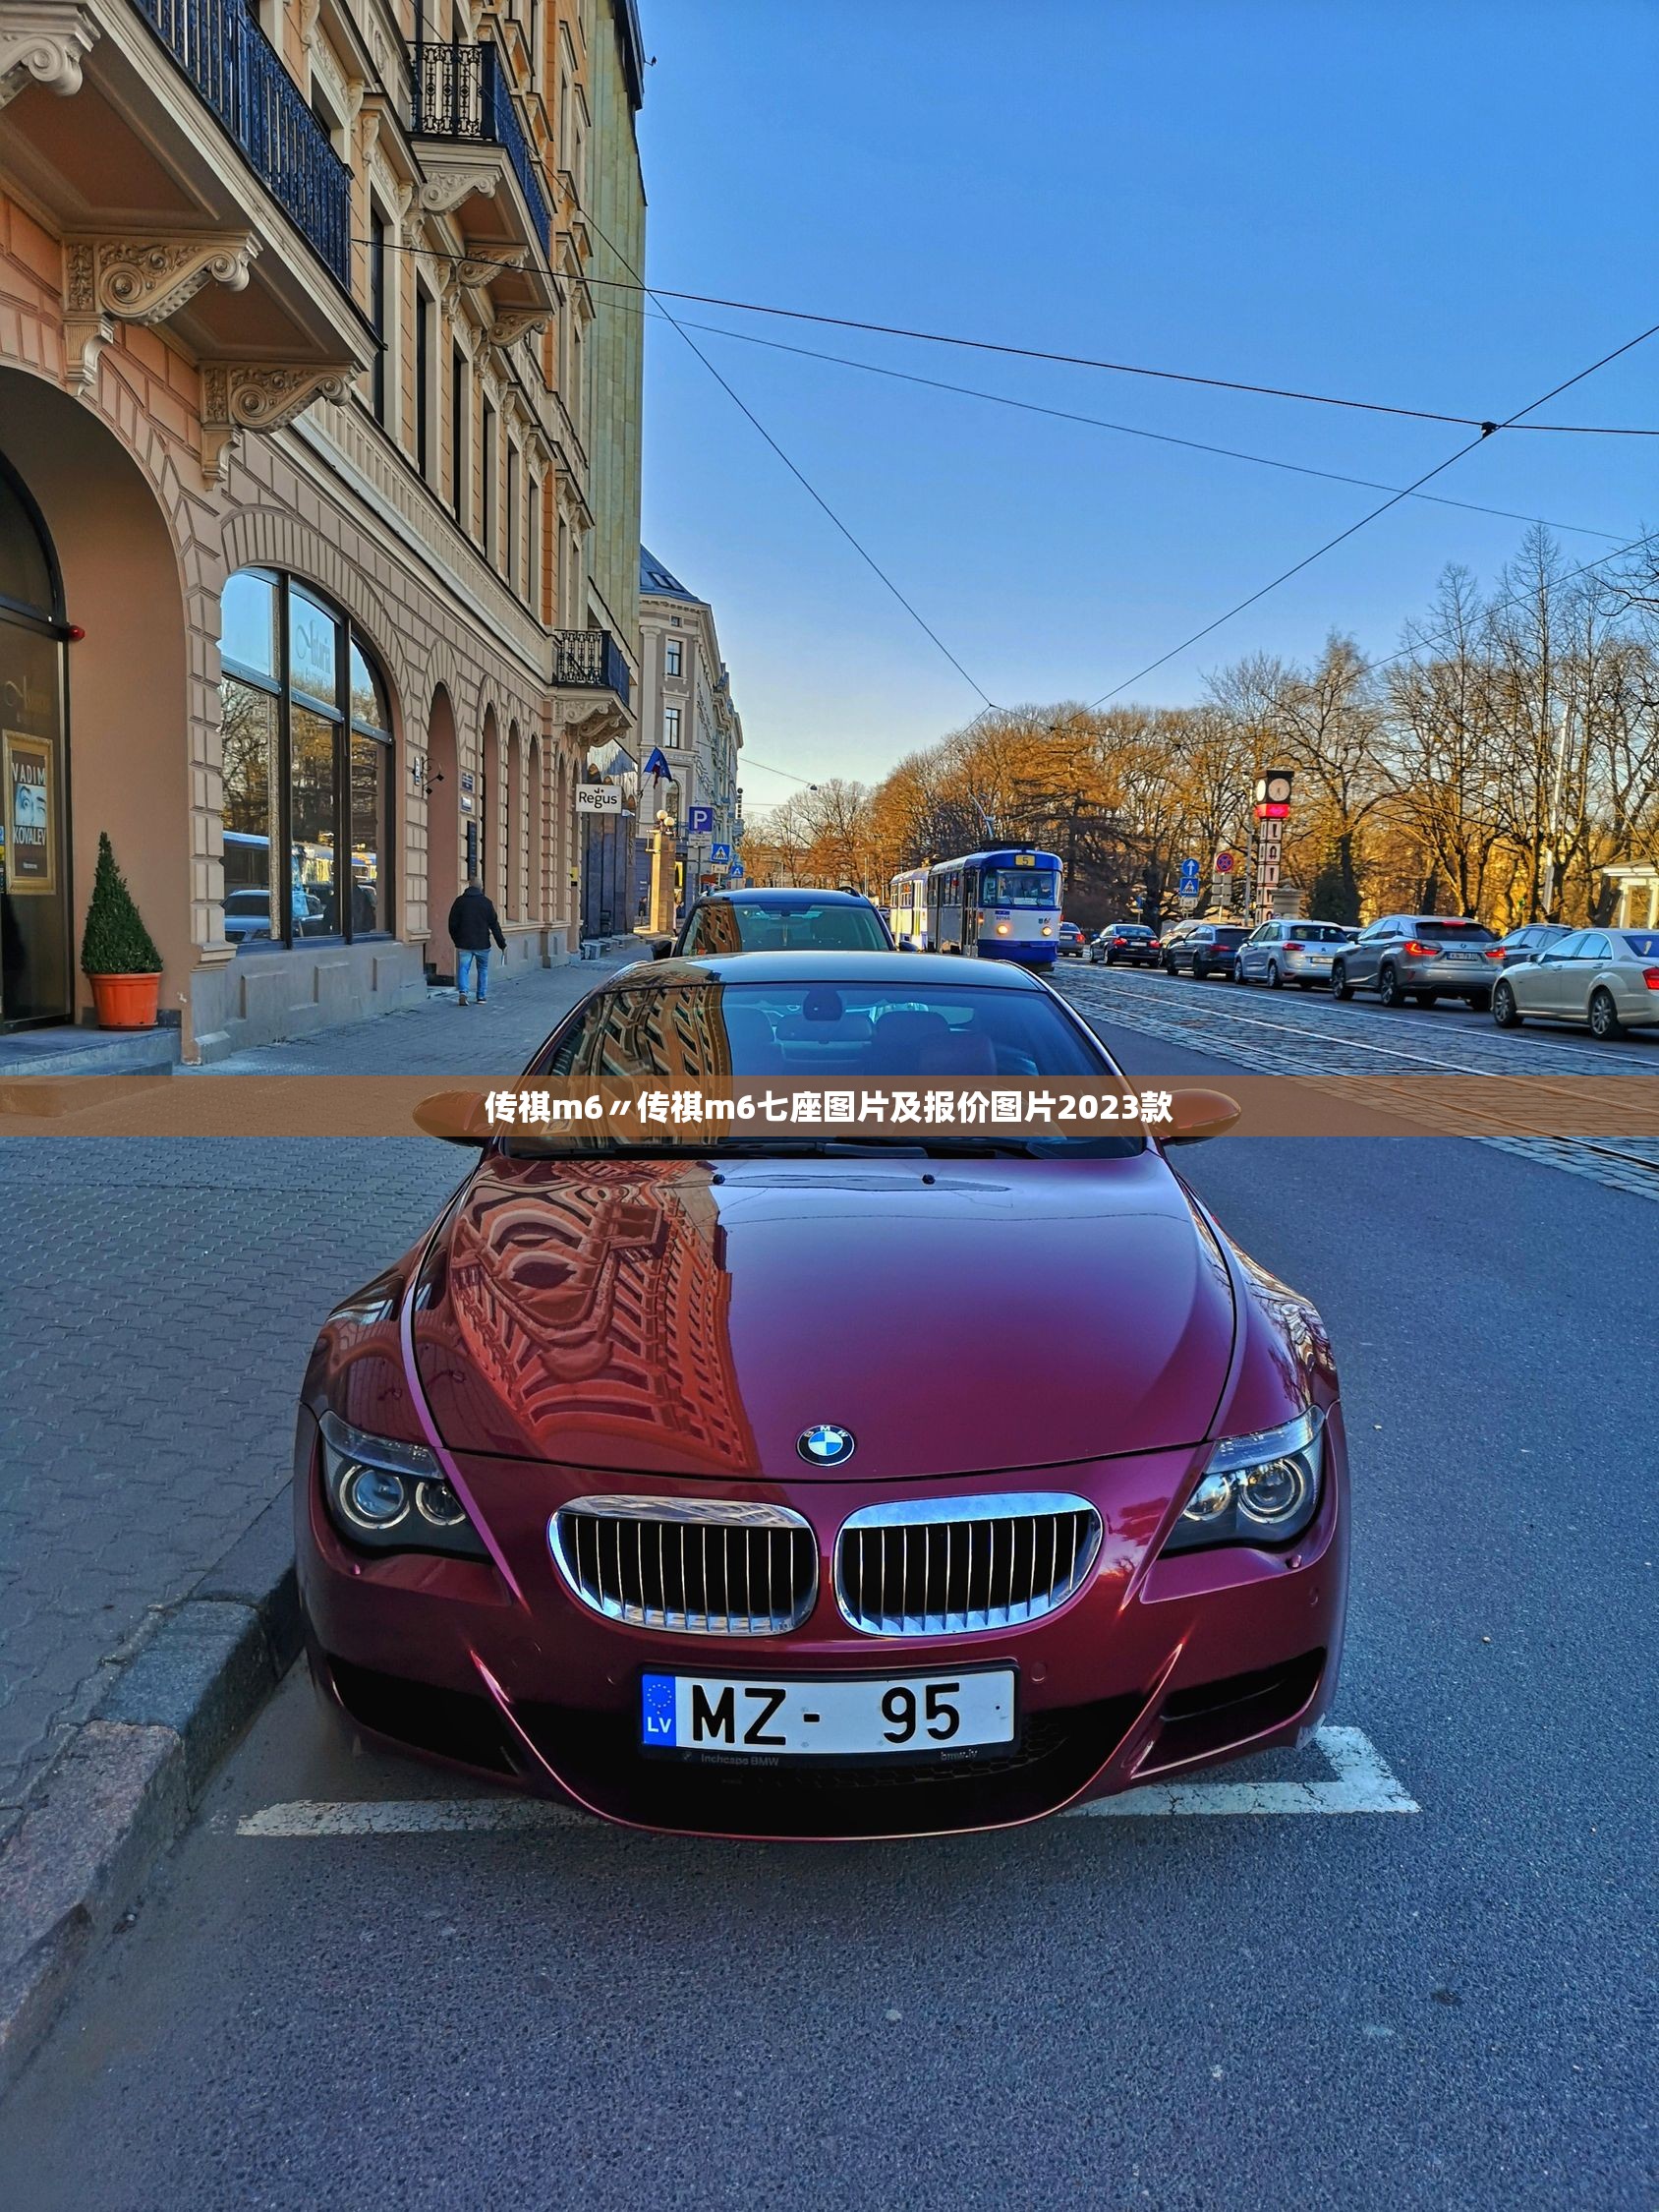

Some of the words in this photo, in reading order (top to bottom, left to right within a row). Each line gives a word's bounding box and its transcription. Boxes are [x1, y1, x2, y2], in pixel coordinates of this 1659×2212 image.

[12, 763, 46, 786] VADIM
[579, 791, 617, 808] Regus
[694, 810, 708, 830] P
[13, 827, 46, 845] KOVALEV
[1022, 856, 1029, 865] 5
[647, 1717, 672, 1733] LV
